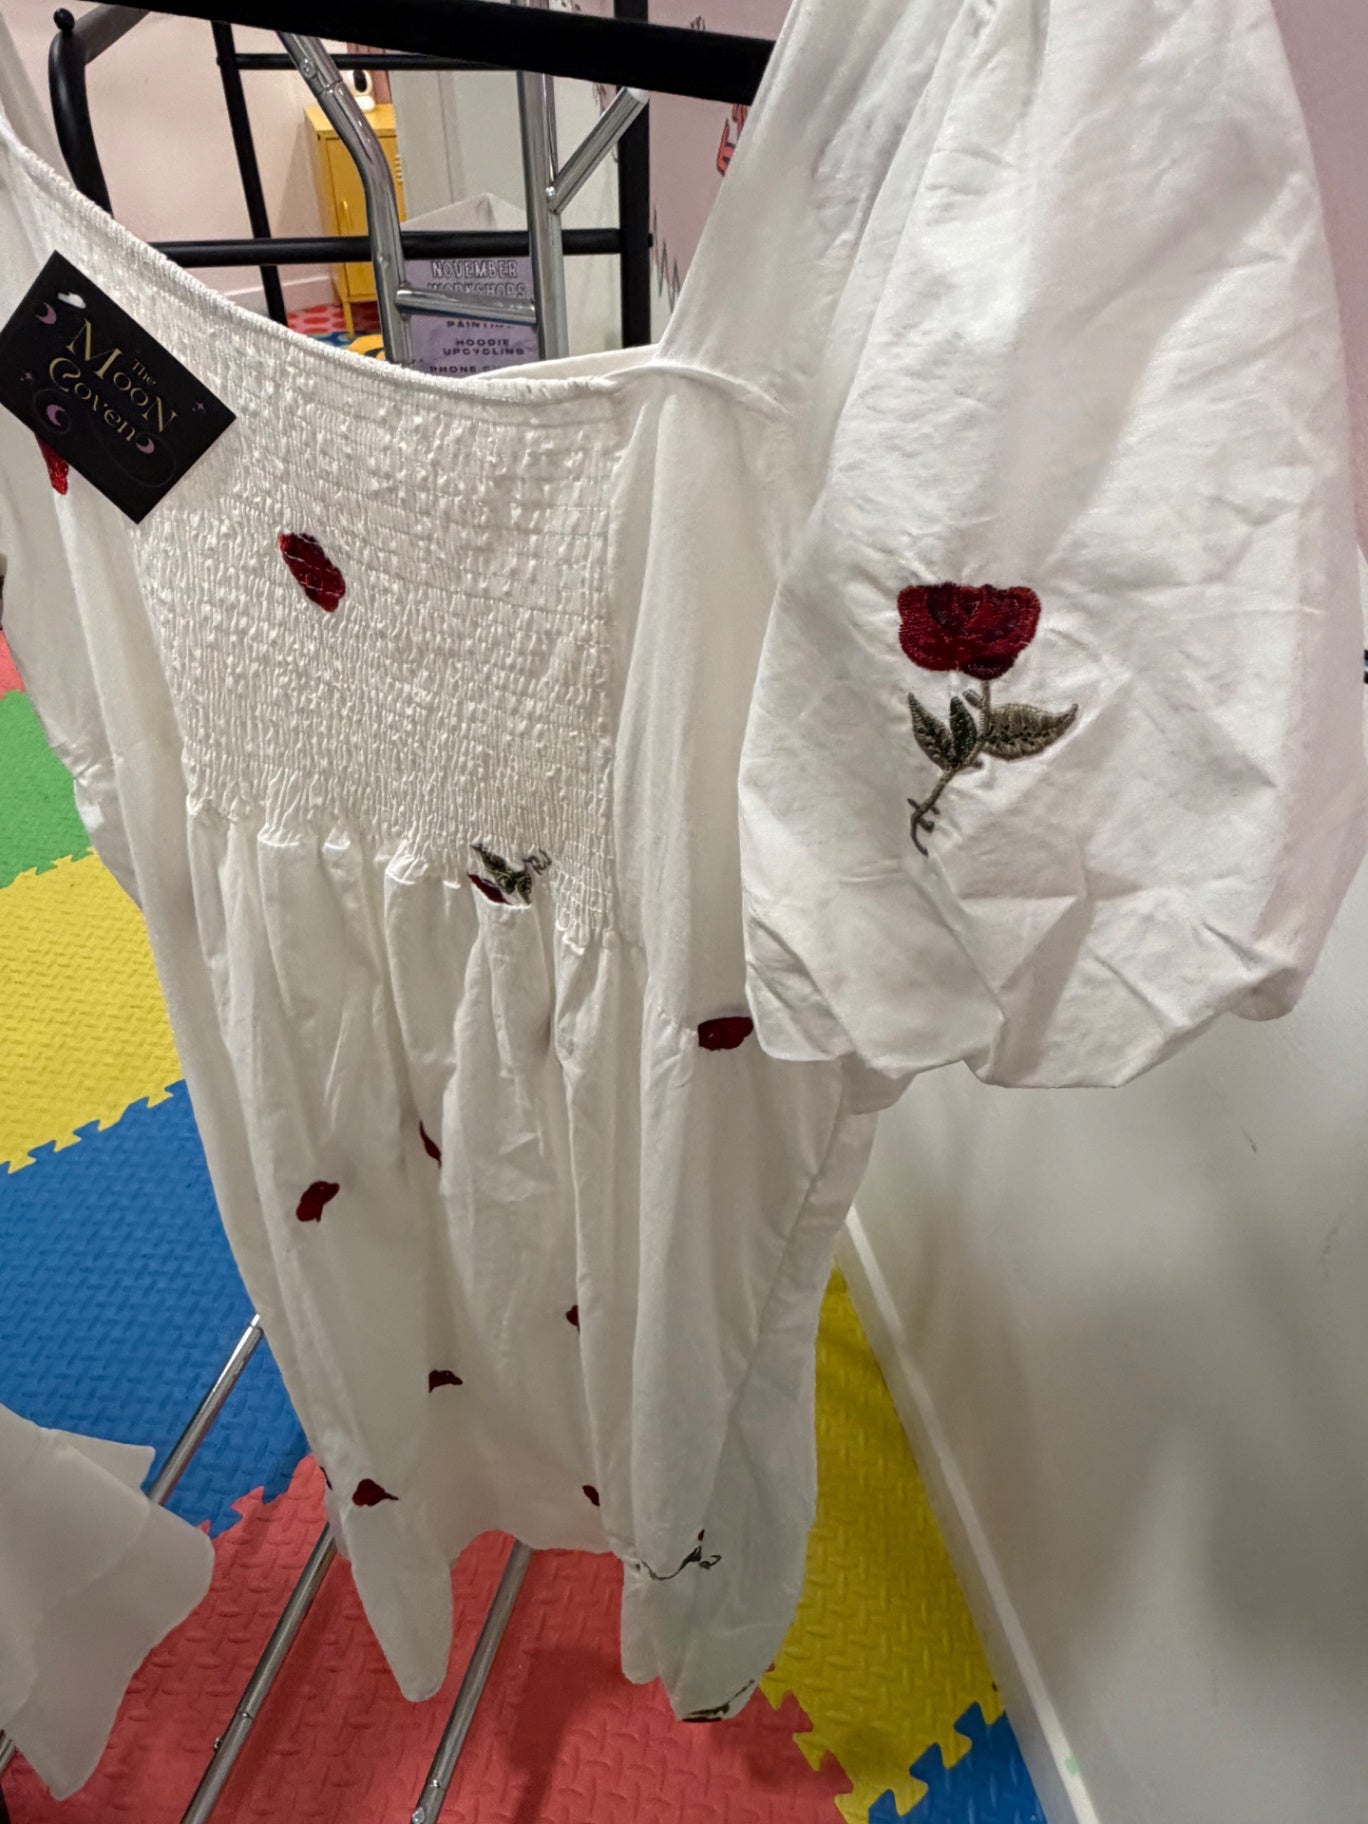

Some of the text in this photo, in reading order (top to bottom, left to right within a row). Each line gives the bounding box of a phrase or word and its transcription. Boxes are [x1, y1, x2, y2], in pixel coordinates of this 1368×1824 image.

[431, 259, 518, 279] NOVEMBER
[456, 339, 510, 347] HOODIE
[443, 347, 525, 356] UPCYCLING
[131, 357, 158, 385] The
[430, 365, 477, 374] PHONE
[48, 357, 136, 442] Coven
